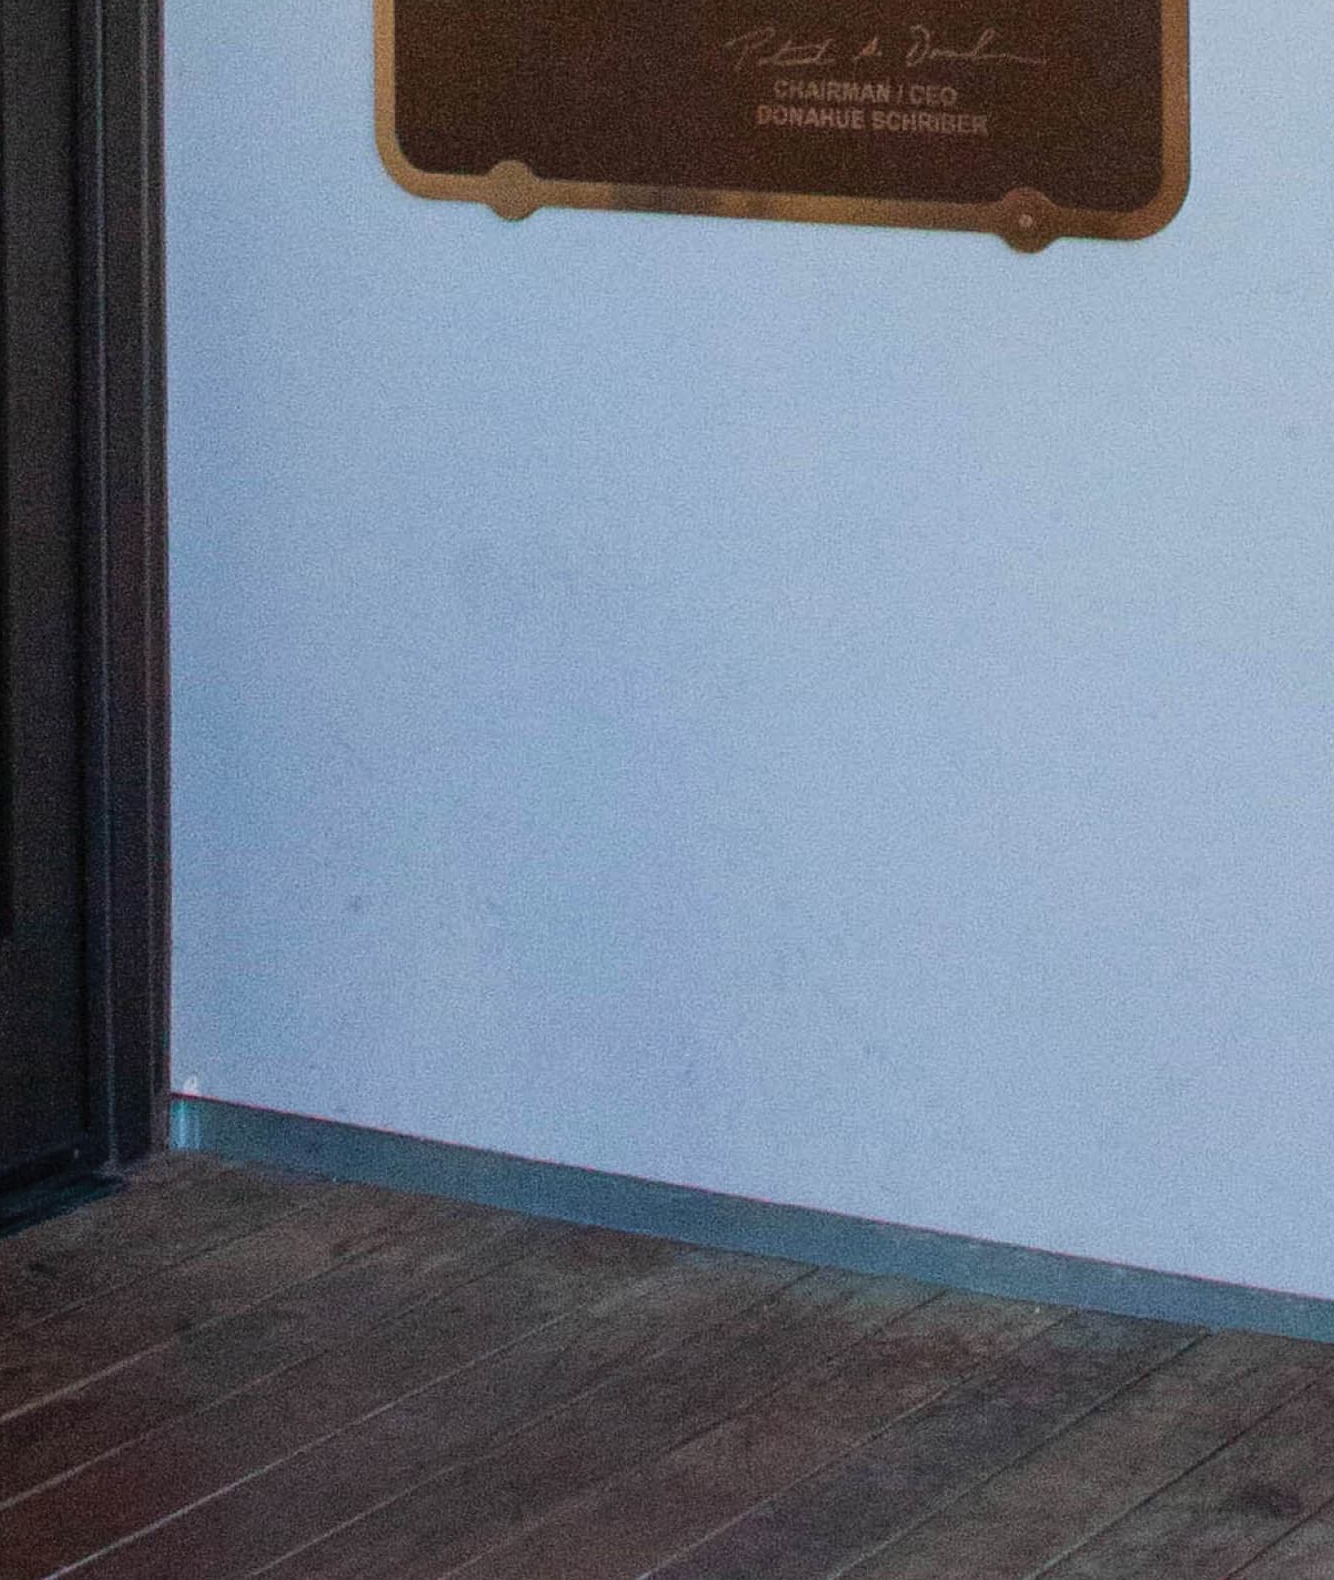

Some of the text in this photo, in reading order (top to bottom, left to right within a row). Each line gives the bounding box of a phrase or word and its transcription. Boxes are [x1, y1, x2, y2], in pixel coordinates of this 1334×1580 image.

[773, 78, 889, 104] CHAIRMAN
[908, 84, 959, 108] CEO
[756, 104, 865, 131] DONAHUE
